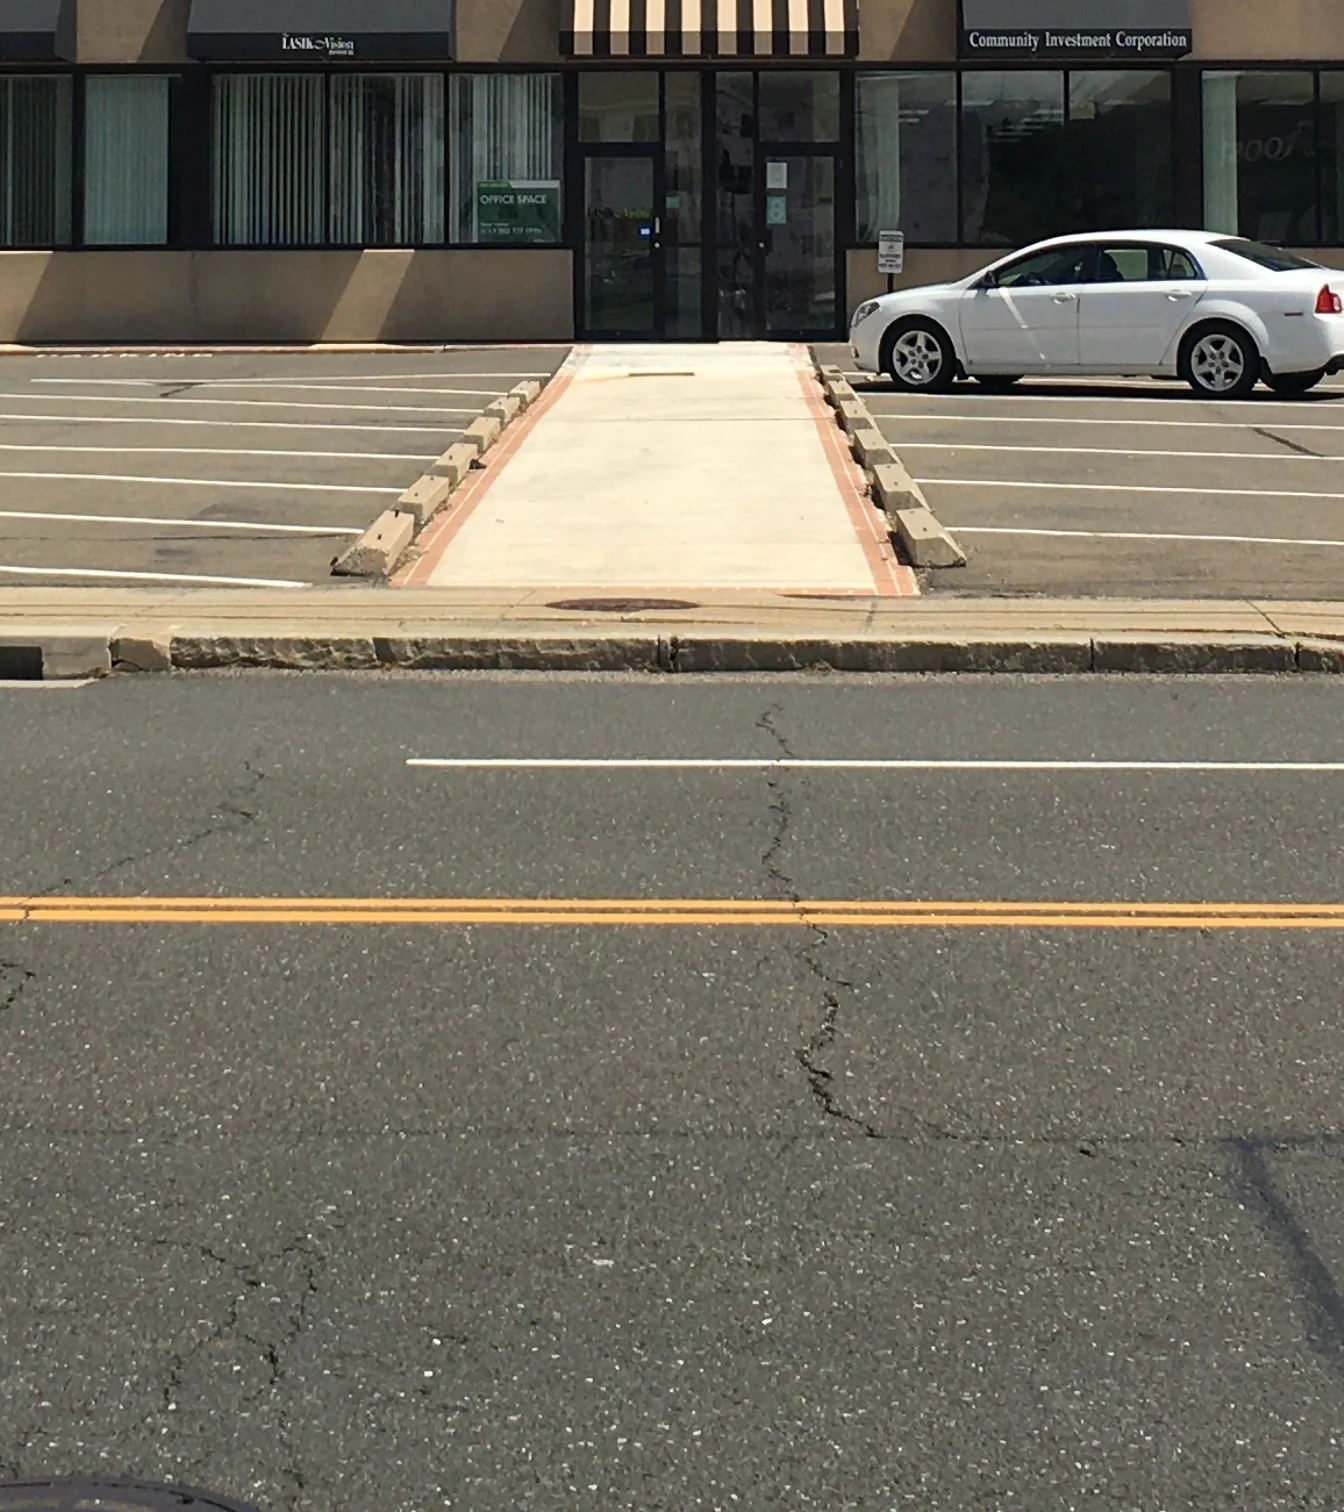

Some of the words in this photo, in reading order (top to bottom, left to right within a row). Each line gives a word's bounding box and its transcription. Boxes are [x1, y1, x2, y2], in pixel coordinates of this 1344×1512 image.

[969, 31, 1039, 51] Community
[1045, 31, 1111, 47] Investment
[1115, 30, 1187, 51] Corporation
[480, 194, 515, 204] OFFICE
[516, 194, 547, 204] SPACE
